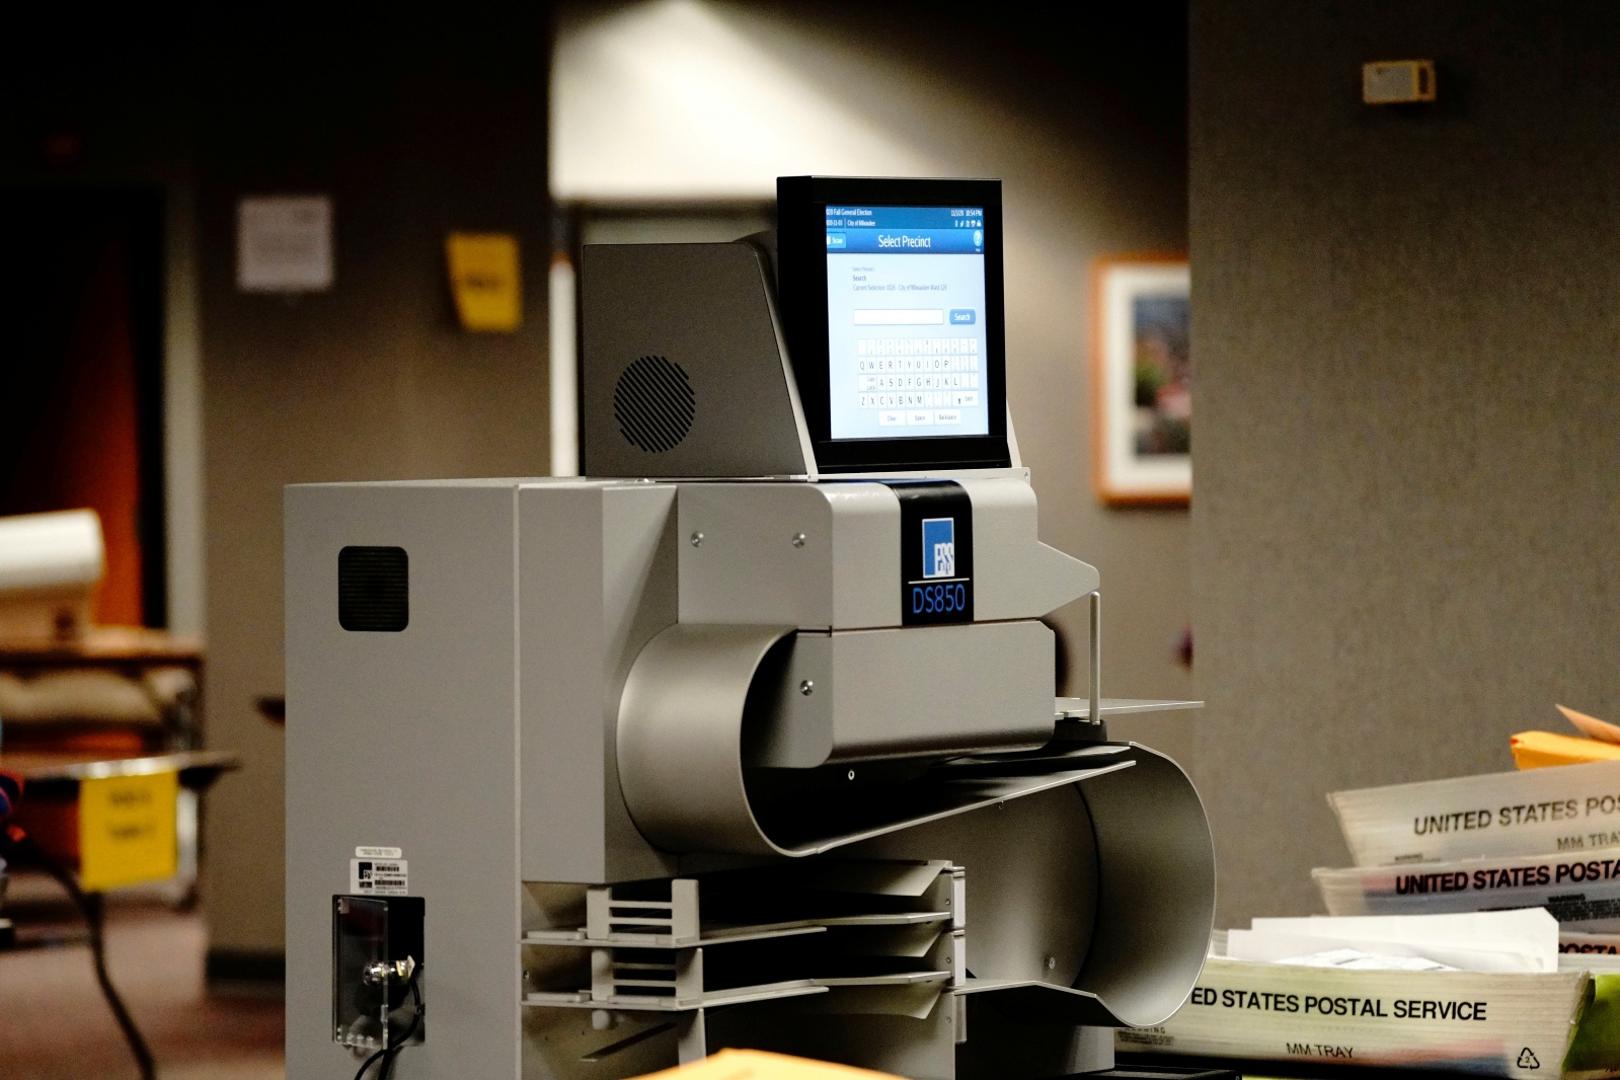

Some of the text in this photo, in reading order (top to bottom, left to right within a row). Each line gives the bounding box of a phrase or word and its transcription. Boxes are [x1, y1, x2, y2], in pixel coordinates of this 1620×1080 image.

[878, 234, 931, 248] Select Precinct
[954, 313, 971, 321] Search
[913, 584, 965, 613] DS850
[1414, 795, 1620, 836] UNITED STATES PO
[1557, 831, 1620, 850] MM TRA
[1396, 871, 1469, 895] UNITED
[1473, 865, 1550, 890] STATES
[1558, 943, 1617, 954] OSTA
[1222, 989, 1300, 1012] STATES
[1305, 996, 1388, 1017] POSTAL
[1393, 1000, 1487, 1021] SERVICE
[1286, 1042, 1354, 1059] MM TRAY
